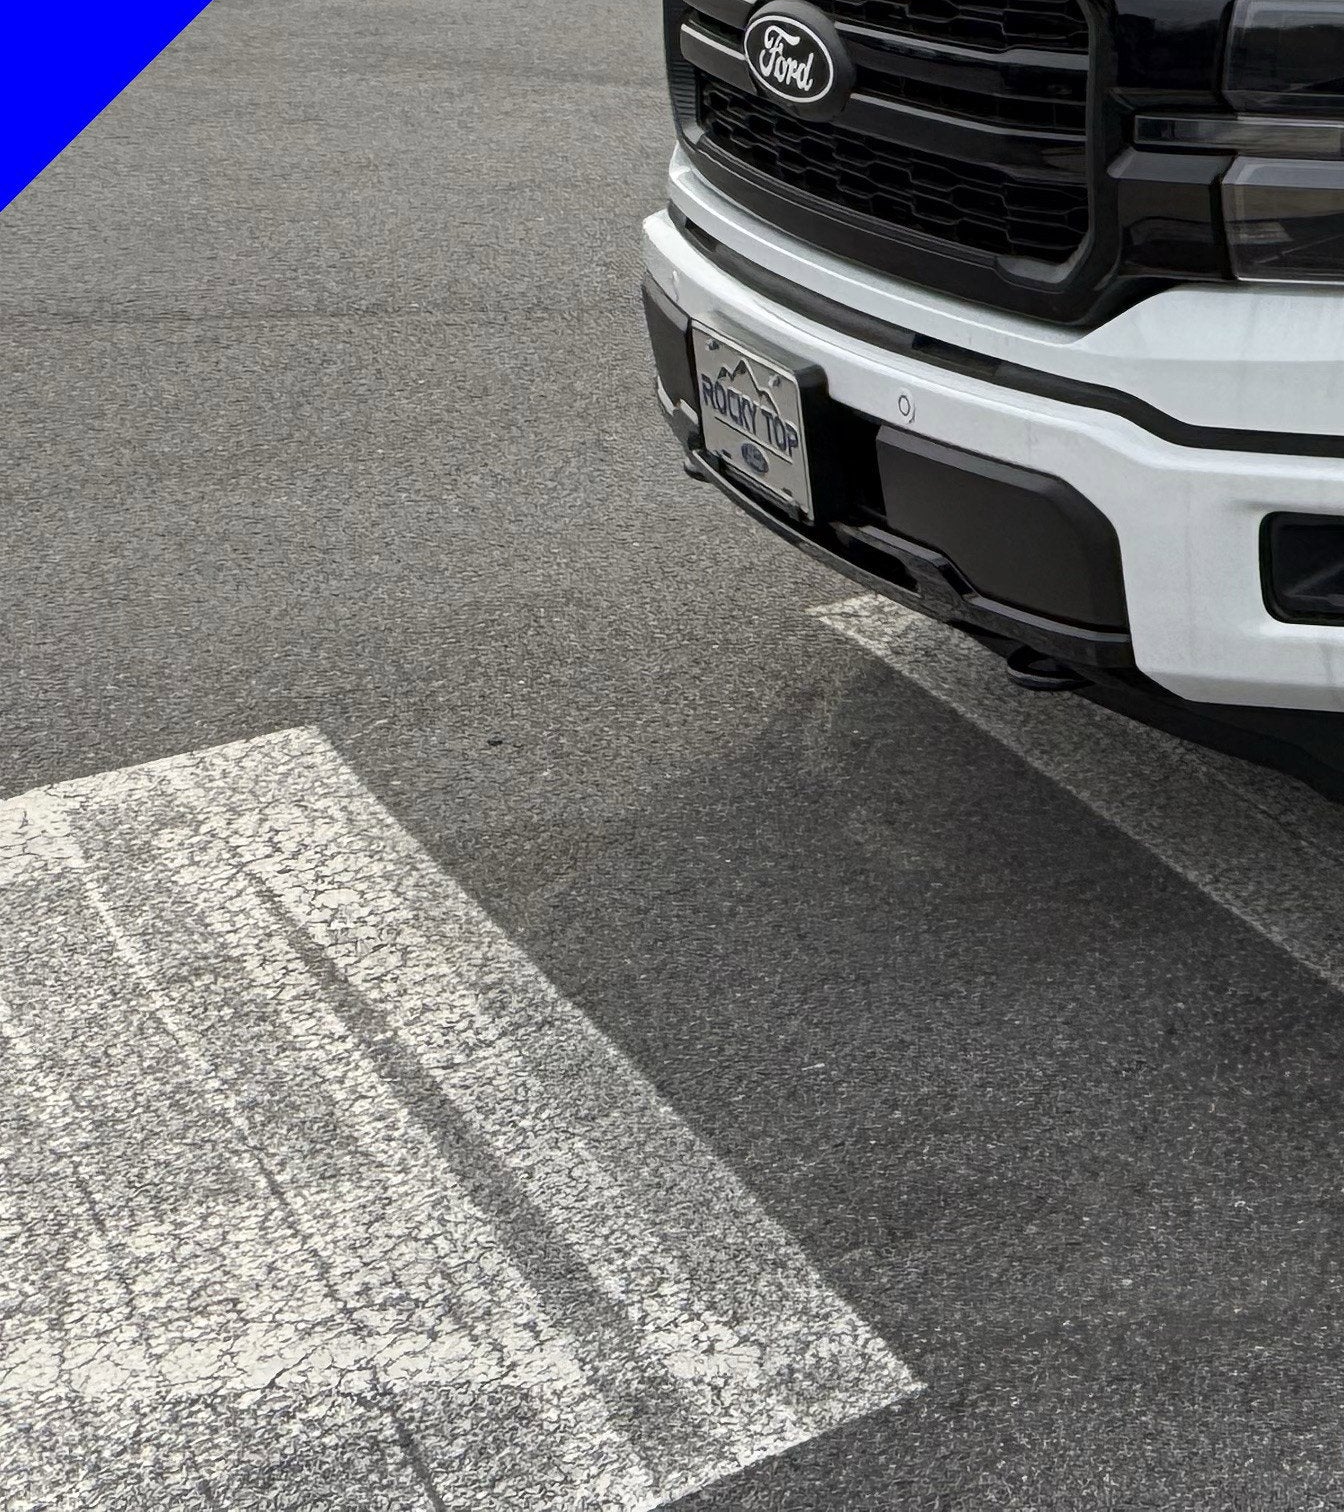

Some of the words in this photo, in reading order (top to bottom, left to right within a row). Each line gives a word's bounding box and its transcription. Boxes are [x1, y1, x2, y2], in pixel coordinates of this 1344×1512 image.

[759, 25, 814, 91] Ford
[701, 373, 758, 436] ROCKY
[760, 405, 799, 458] TOP
